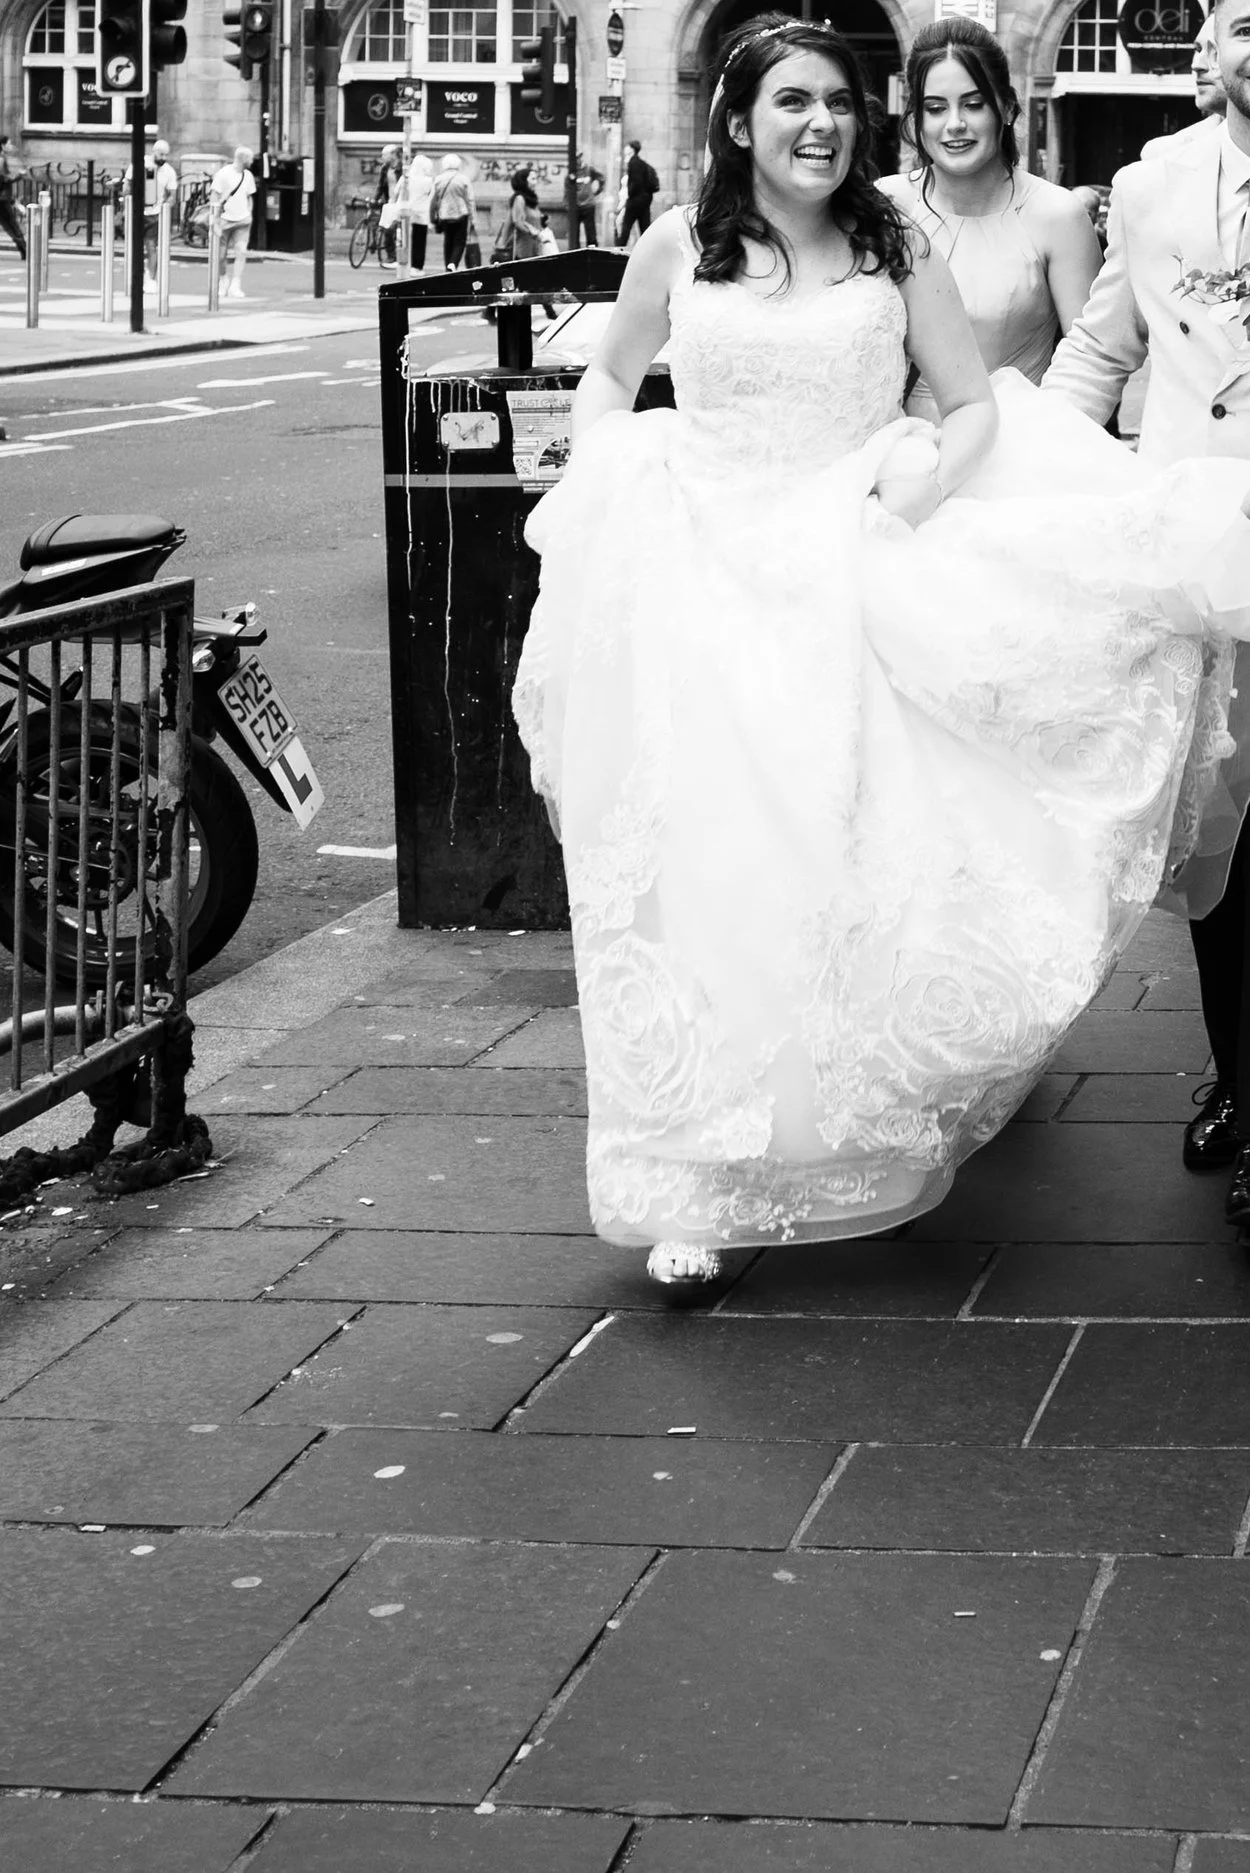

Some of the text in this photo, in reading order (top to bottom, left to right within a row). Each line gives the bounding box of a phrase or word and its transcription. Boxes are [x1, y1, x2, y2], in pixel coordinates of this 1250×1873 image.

[224, 661, 273, 723] SH25
[249, 699, 289, 753] FZB
[277, 753, 313, 806] L
